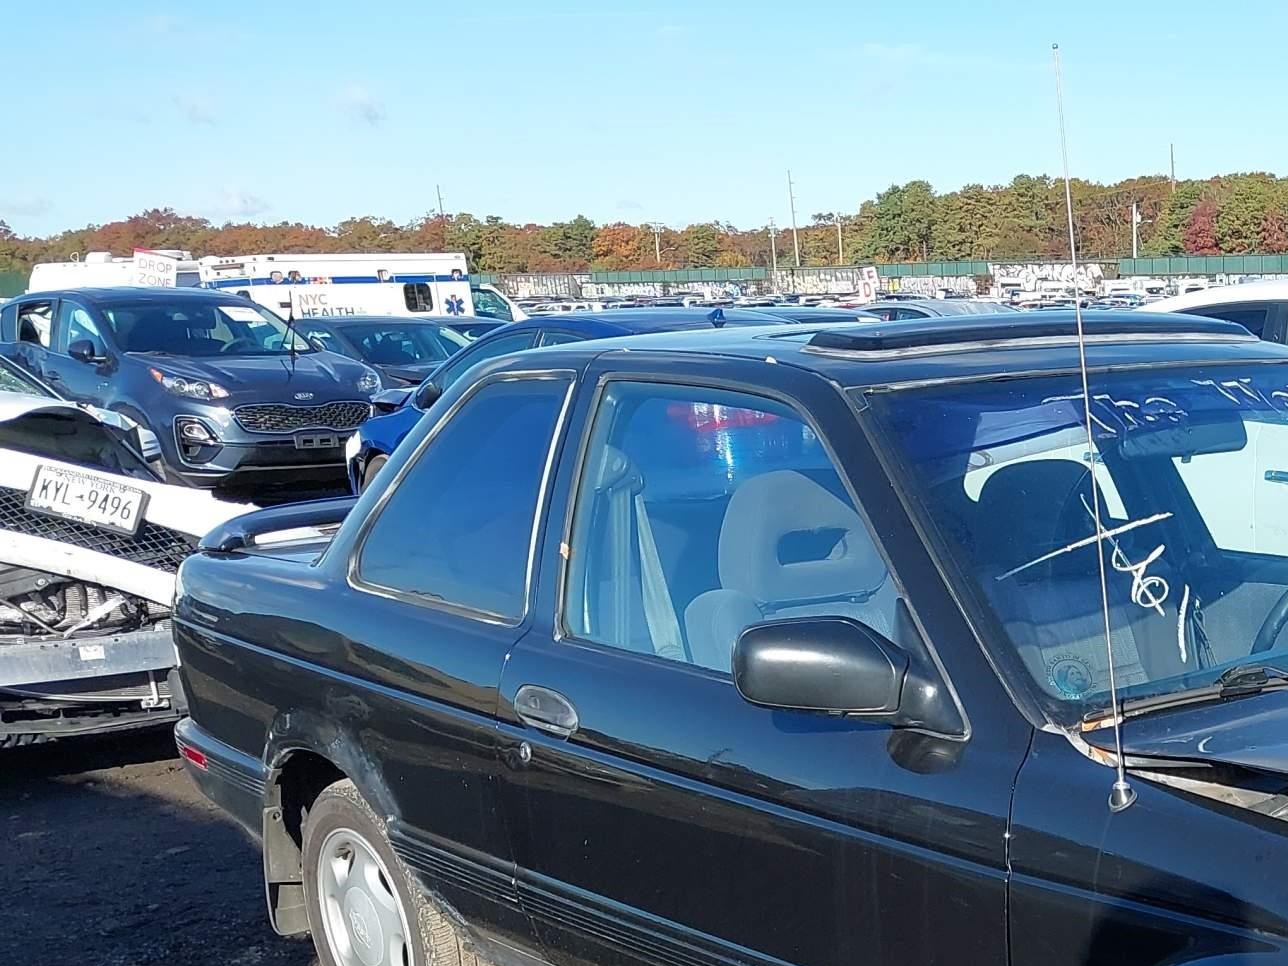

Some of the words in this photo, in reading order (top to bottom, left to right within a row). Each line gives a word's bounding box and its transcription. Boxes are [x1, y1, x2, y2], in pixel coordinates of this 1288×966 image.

[138, 258, 172, 273] DROP
[139, 272, 172, 288] ZONE
[299, 293, 328, 306] NYC
[301, 306, 355, 318] HEALTH
[64, 474, 86, 486] NEW
[89, 481, 116, 494] YORK
[87, 489, 132, 520] 9496
